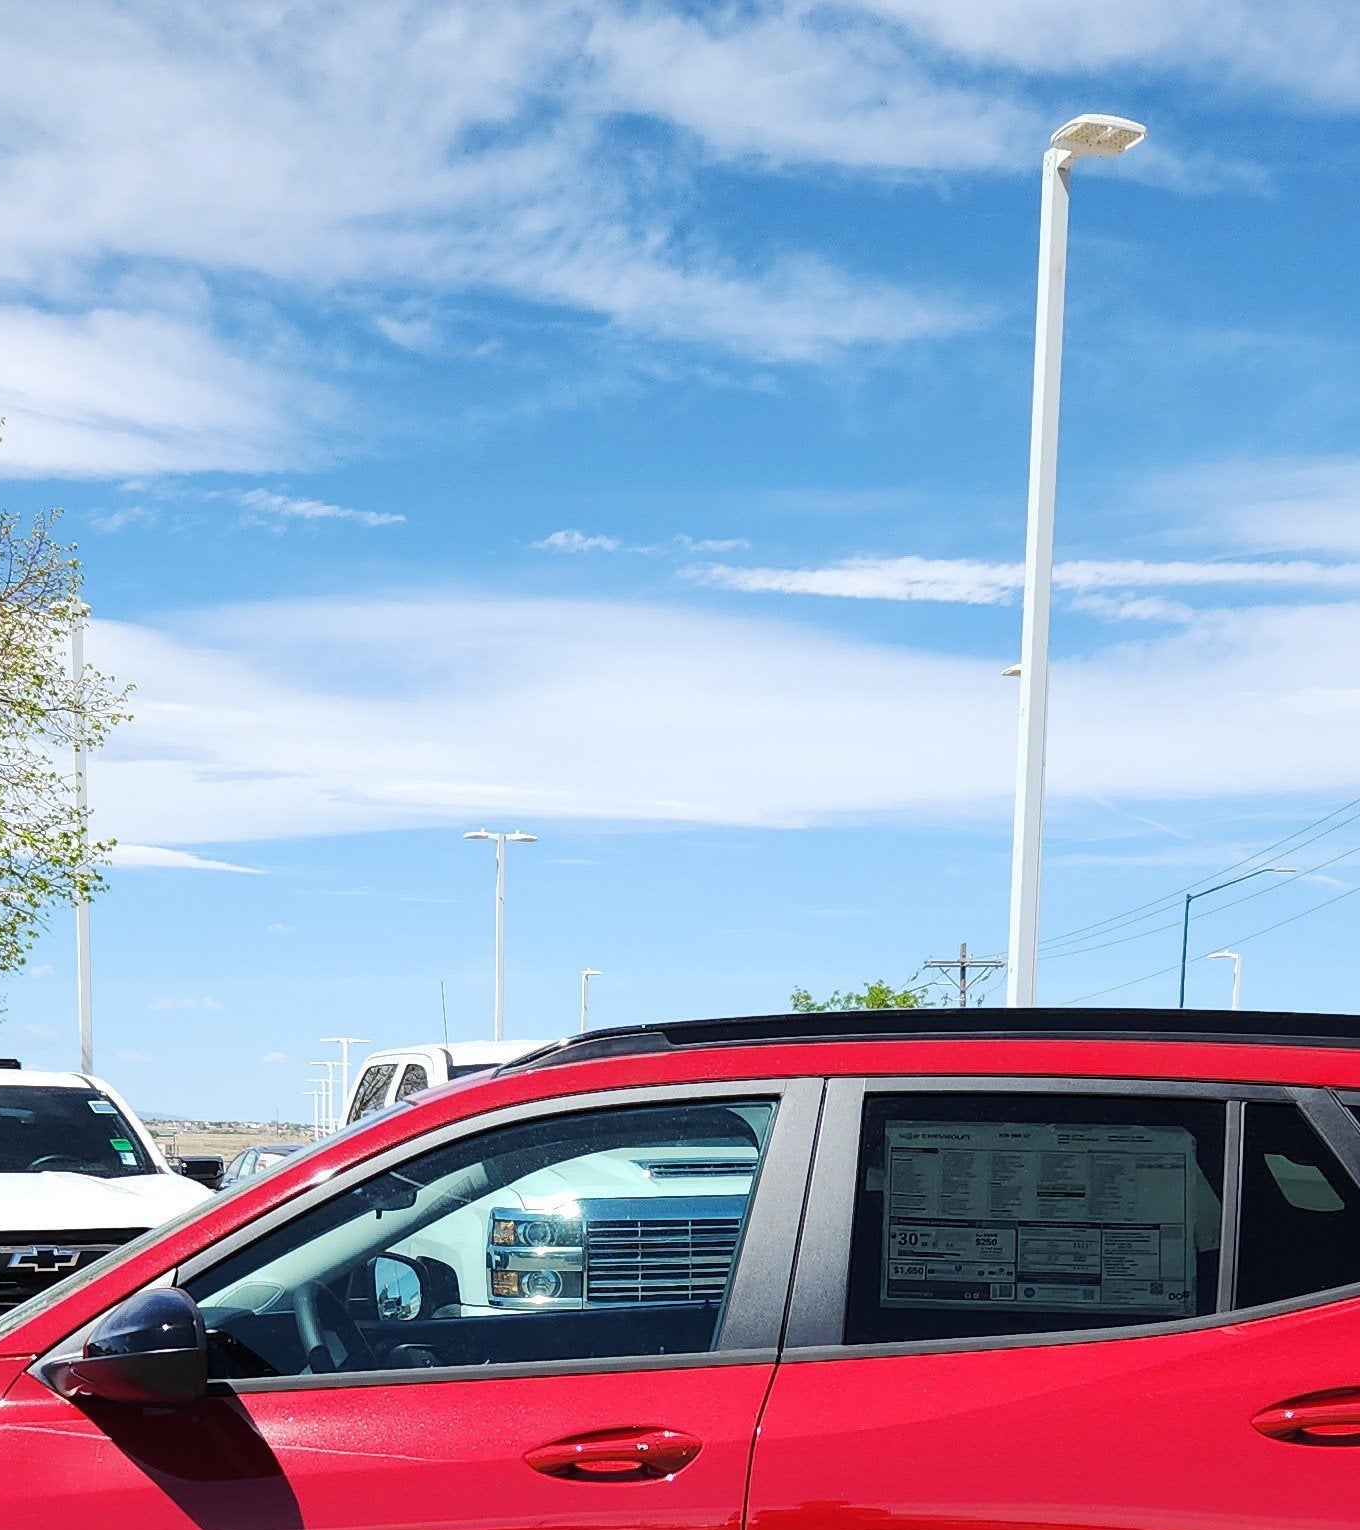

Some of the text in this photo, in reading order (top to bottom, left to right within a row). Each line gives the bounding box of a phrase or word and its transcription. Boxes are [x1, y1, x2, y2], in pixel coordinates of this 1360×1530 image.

[898, 1232, 919, 1247] 30
[975, 1237, 998, 1246] $250
[893, 1266, 924, 1276] $1,650
